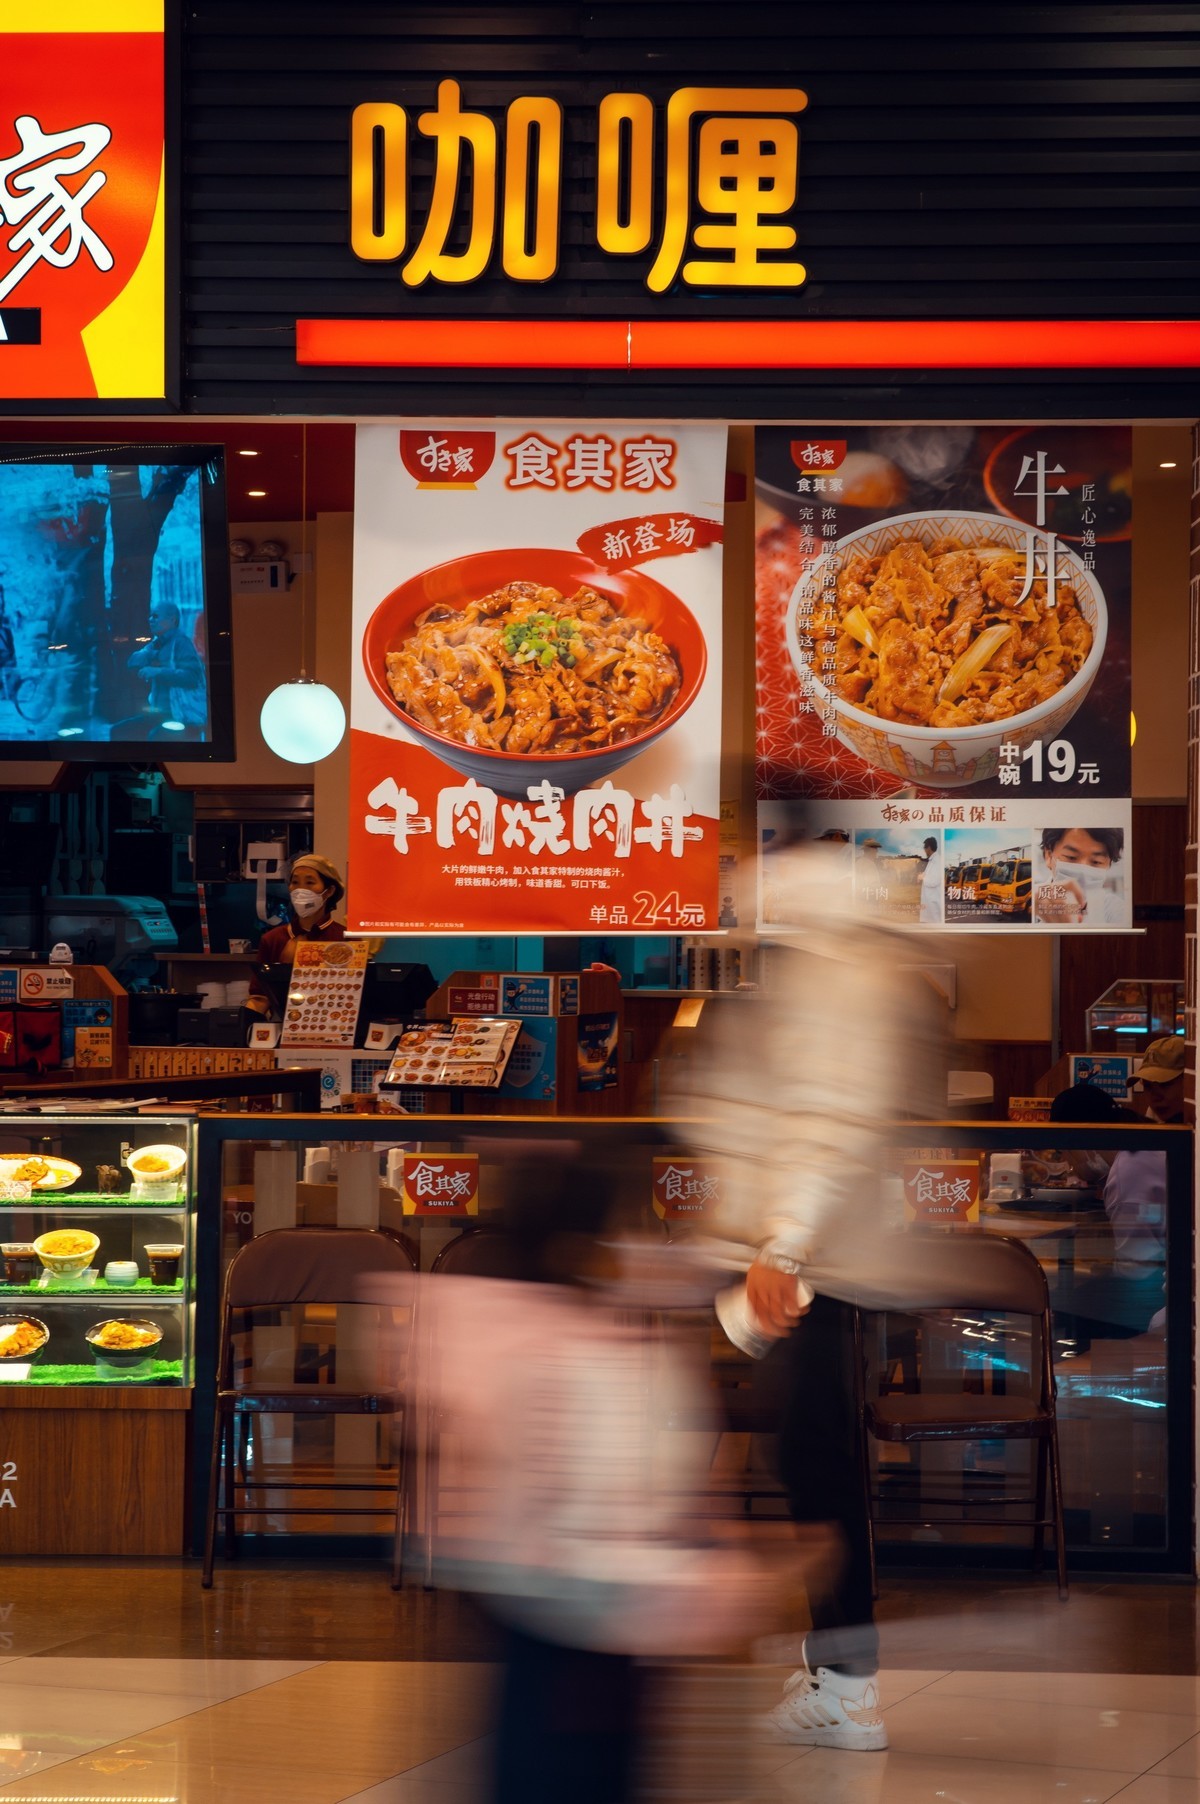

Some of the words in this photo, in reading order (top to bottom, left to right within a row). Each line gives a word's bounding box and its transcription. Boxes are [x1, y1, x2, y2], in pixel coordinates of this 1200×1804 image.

[350, 78, 809, 293] 咖喱
[0, 115, 115, 302] 家
[416, 435, 475, 478] すき家
[505, 437, 674, 489] 食其家
[800, 443, 836, 468] すき家
[796, 477, 844, 493] 食其家
[601, 517, 697, 561] 新登场
[1013, 450, 1071, 607] 牛丼
[1080, 483, 1097, 571] 匠心逸品
[999, 741, 1021, 786] 中碗
[364, 776, 704, 858] 牛肉烧肉丼
[589, 905, 629, 926] 单品
[632, 890, 706, 927] 24元
[947, 885, 977, 900] 物流
[1038, 885, 1067, 900] 质检
[407, 1160, 471, 1200] 食其家
[907, 1166, 972, 1207] 食其家
[0, 1461, 18, 1481] 2
